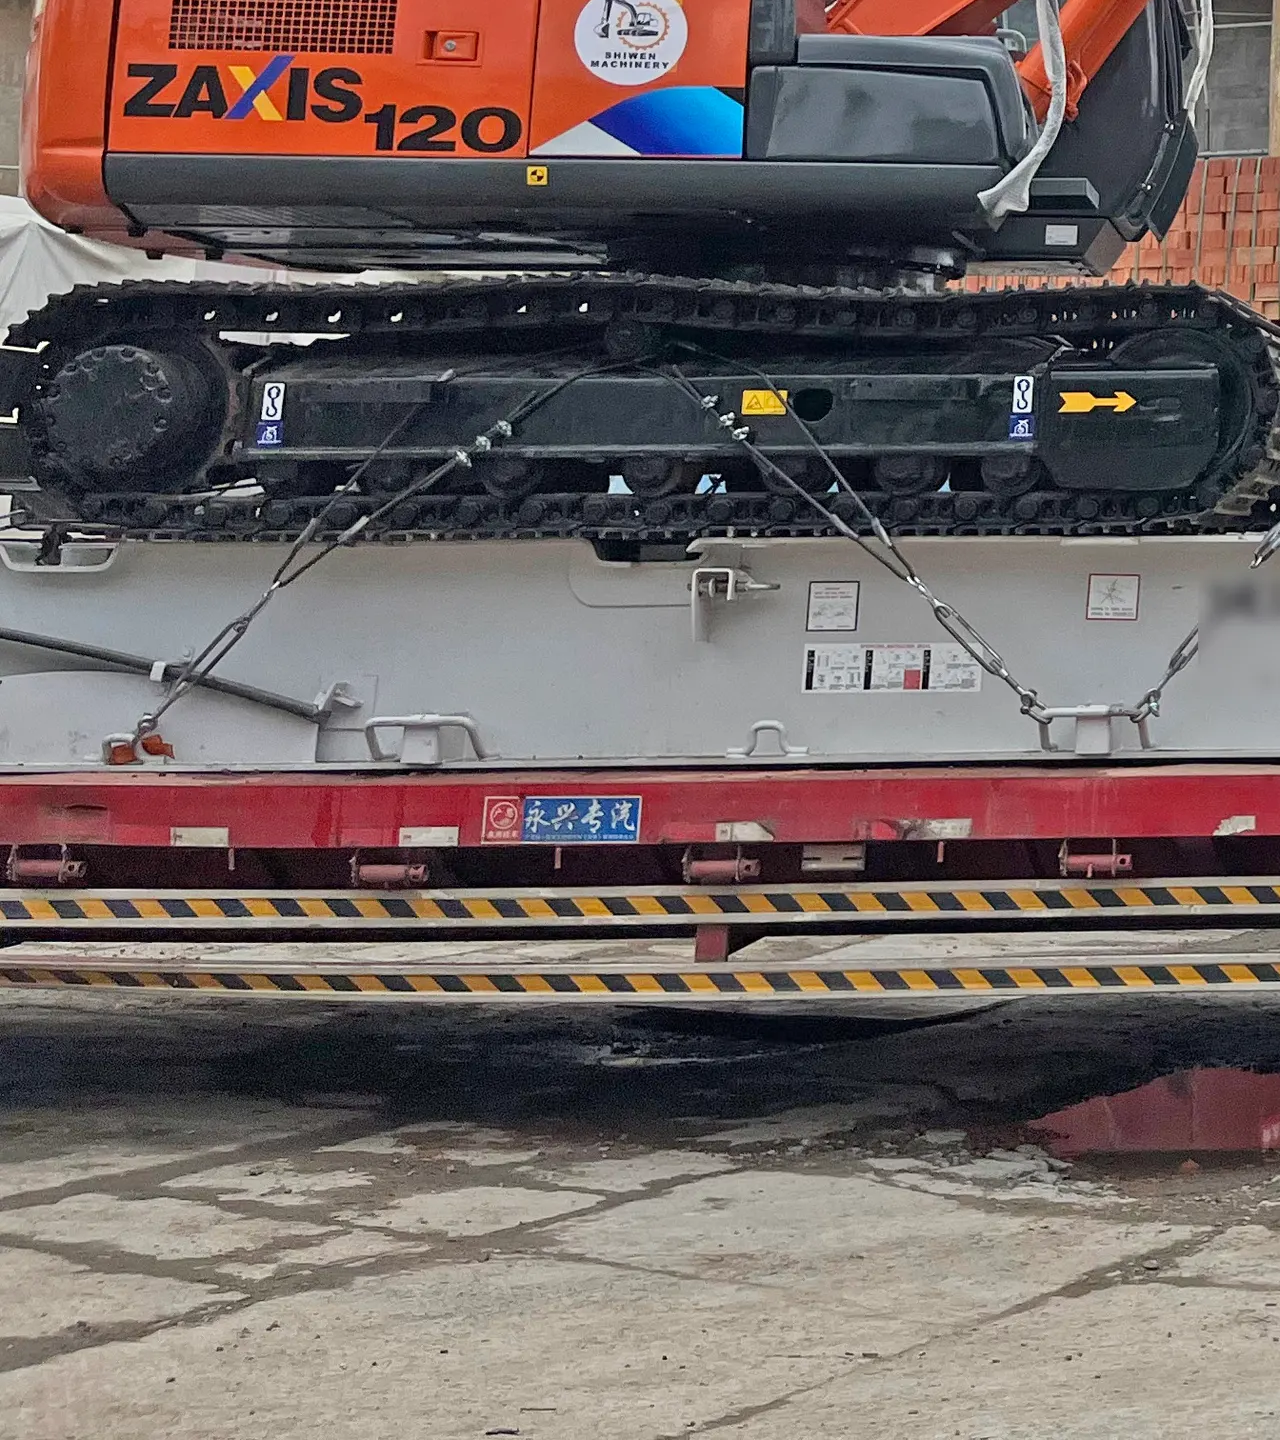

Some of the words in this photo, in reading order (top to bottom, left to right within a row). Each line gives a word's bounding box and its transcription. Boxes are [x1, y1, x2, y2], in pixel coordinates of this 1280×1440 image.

[605, 51, 656, 60] SHIWEN
[590, 60, 670, 69] MACHINERY
[123, 55, 364, 123] ZAXIS
[364, 104, 523, 153] 120
